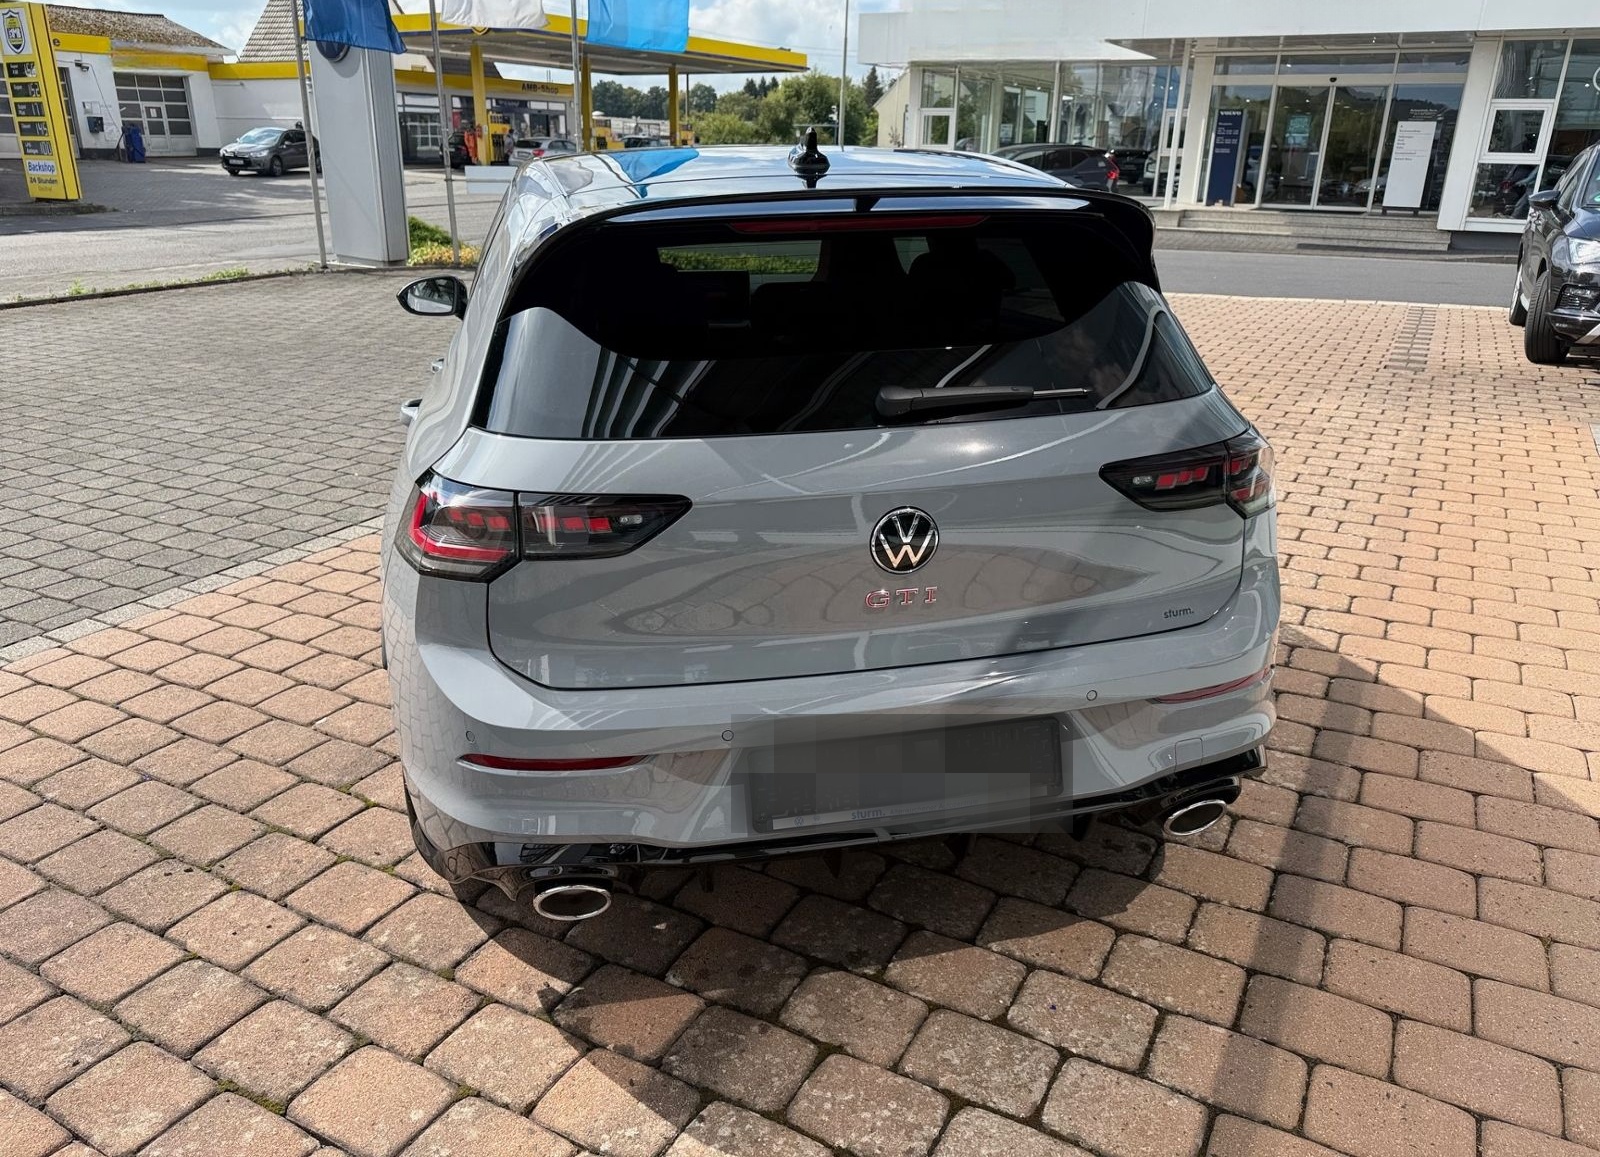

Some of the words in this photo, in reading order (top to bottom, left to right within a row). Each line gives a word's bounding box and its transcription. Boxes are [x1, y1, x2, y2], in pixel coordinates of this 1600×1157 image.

[521, 83, 559, 95] AMB-Shop
[28, 161, 55, 174] Backshop
[865, 586, 938, 608] GTI
